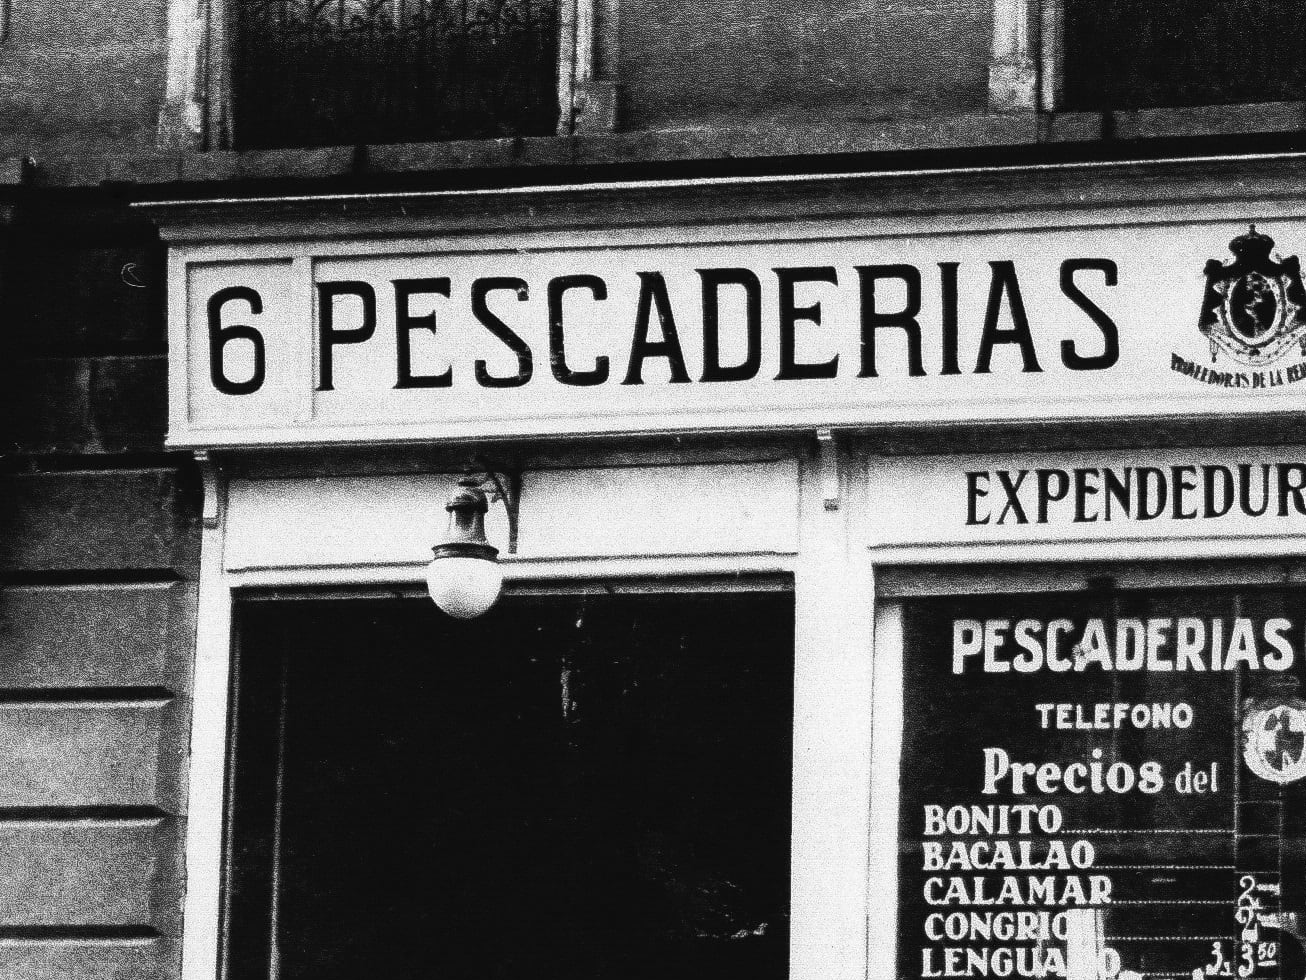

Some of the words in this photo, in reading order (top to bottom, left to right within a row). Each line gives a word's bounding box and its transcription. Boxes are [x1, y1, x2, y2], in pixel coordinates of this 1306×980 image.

[206, 286, 266, 396] 6
[315, 256, 1120, 392] PESCADERIAS
[952, 617, 1294, 674] PESCADERIAS
[1035, 703, 1194, 729] TELEFONO
[981, 747, 1165, 795] Precios
[1174, 762, 1219, 794] del
[923, 804, 1063, 835] BONITO
[922, 840, 1096, 871] BACALAO
[923, 875, 1112, 905] CALAMAR
